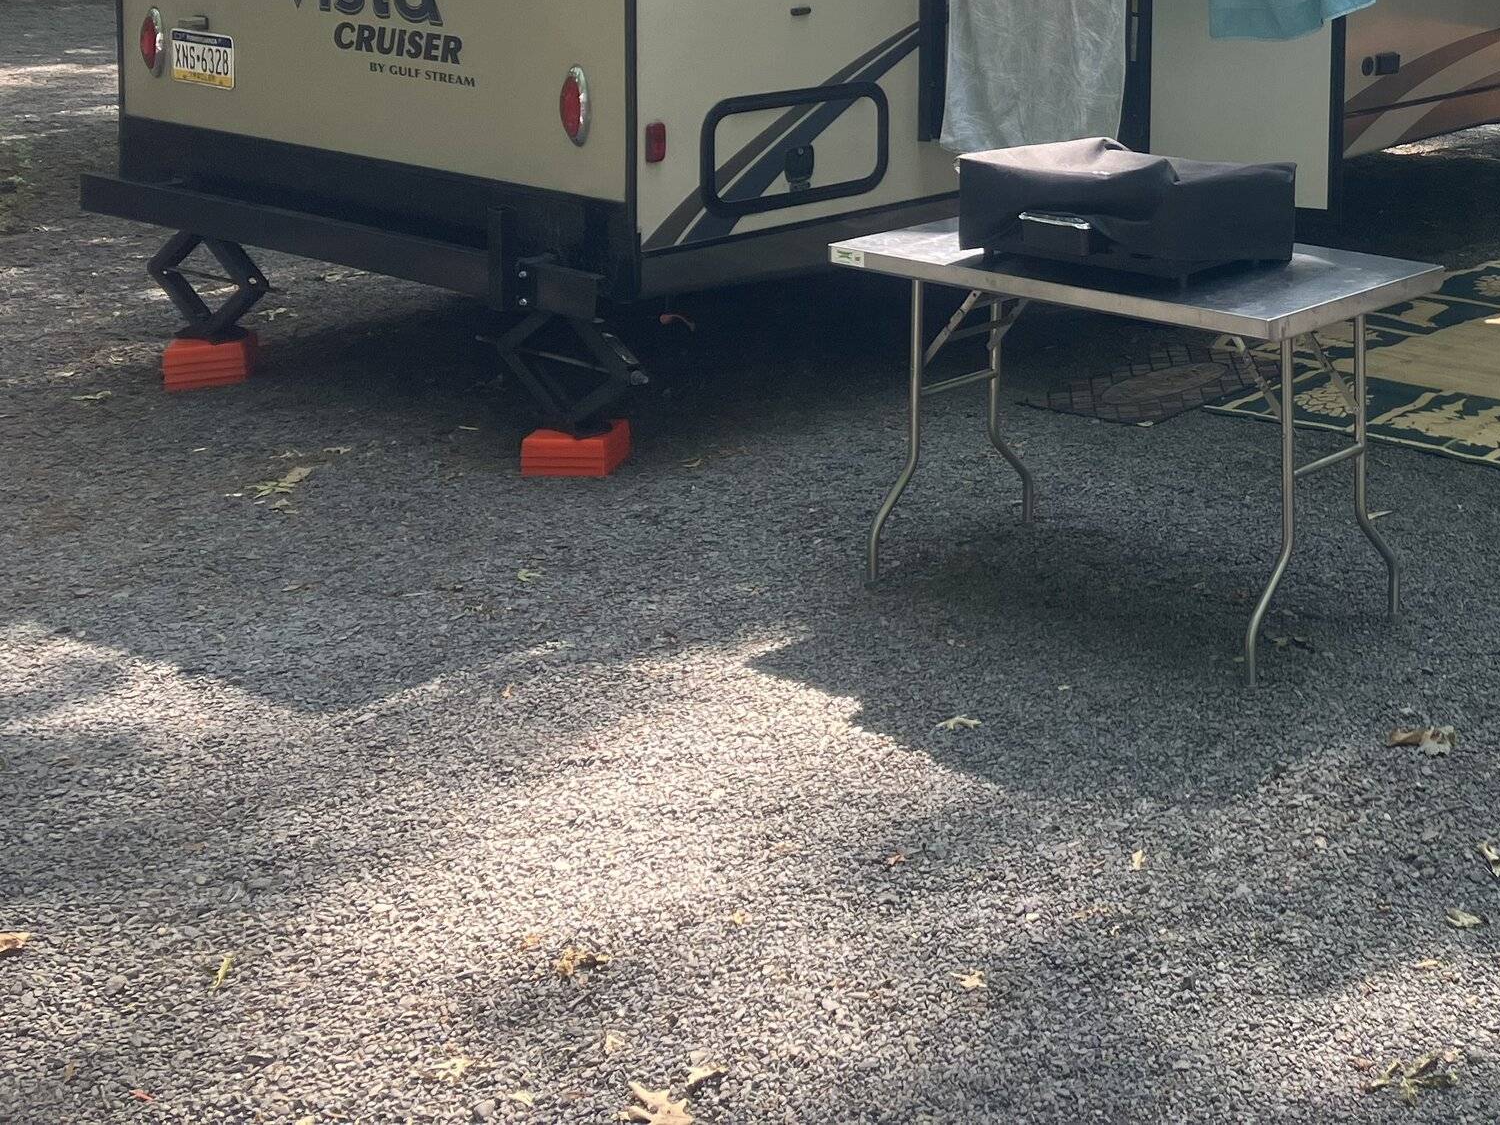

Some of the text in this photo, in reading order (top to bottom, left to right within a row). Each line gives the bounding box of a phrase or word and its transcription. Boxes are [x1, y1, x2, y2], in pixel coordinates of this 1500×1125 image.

[333, 21, 463, 65] CRUISER
[369, 62, 476, 88] BY GULF STREAM
